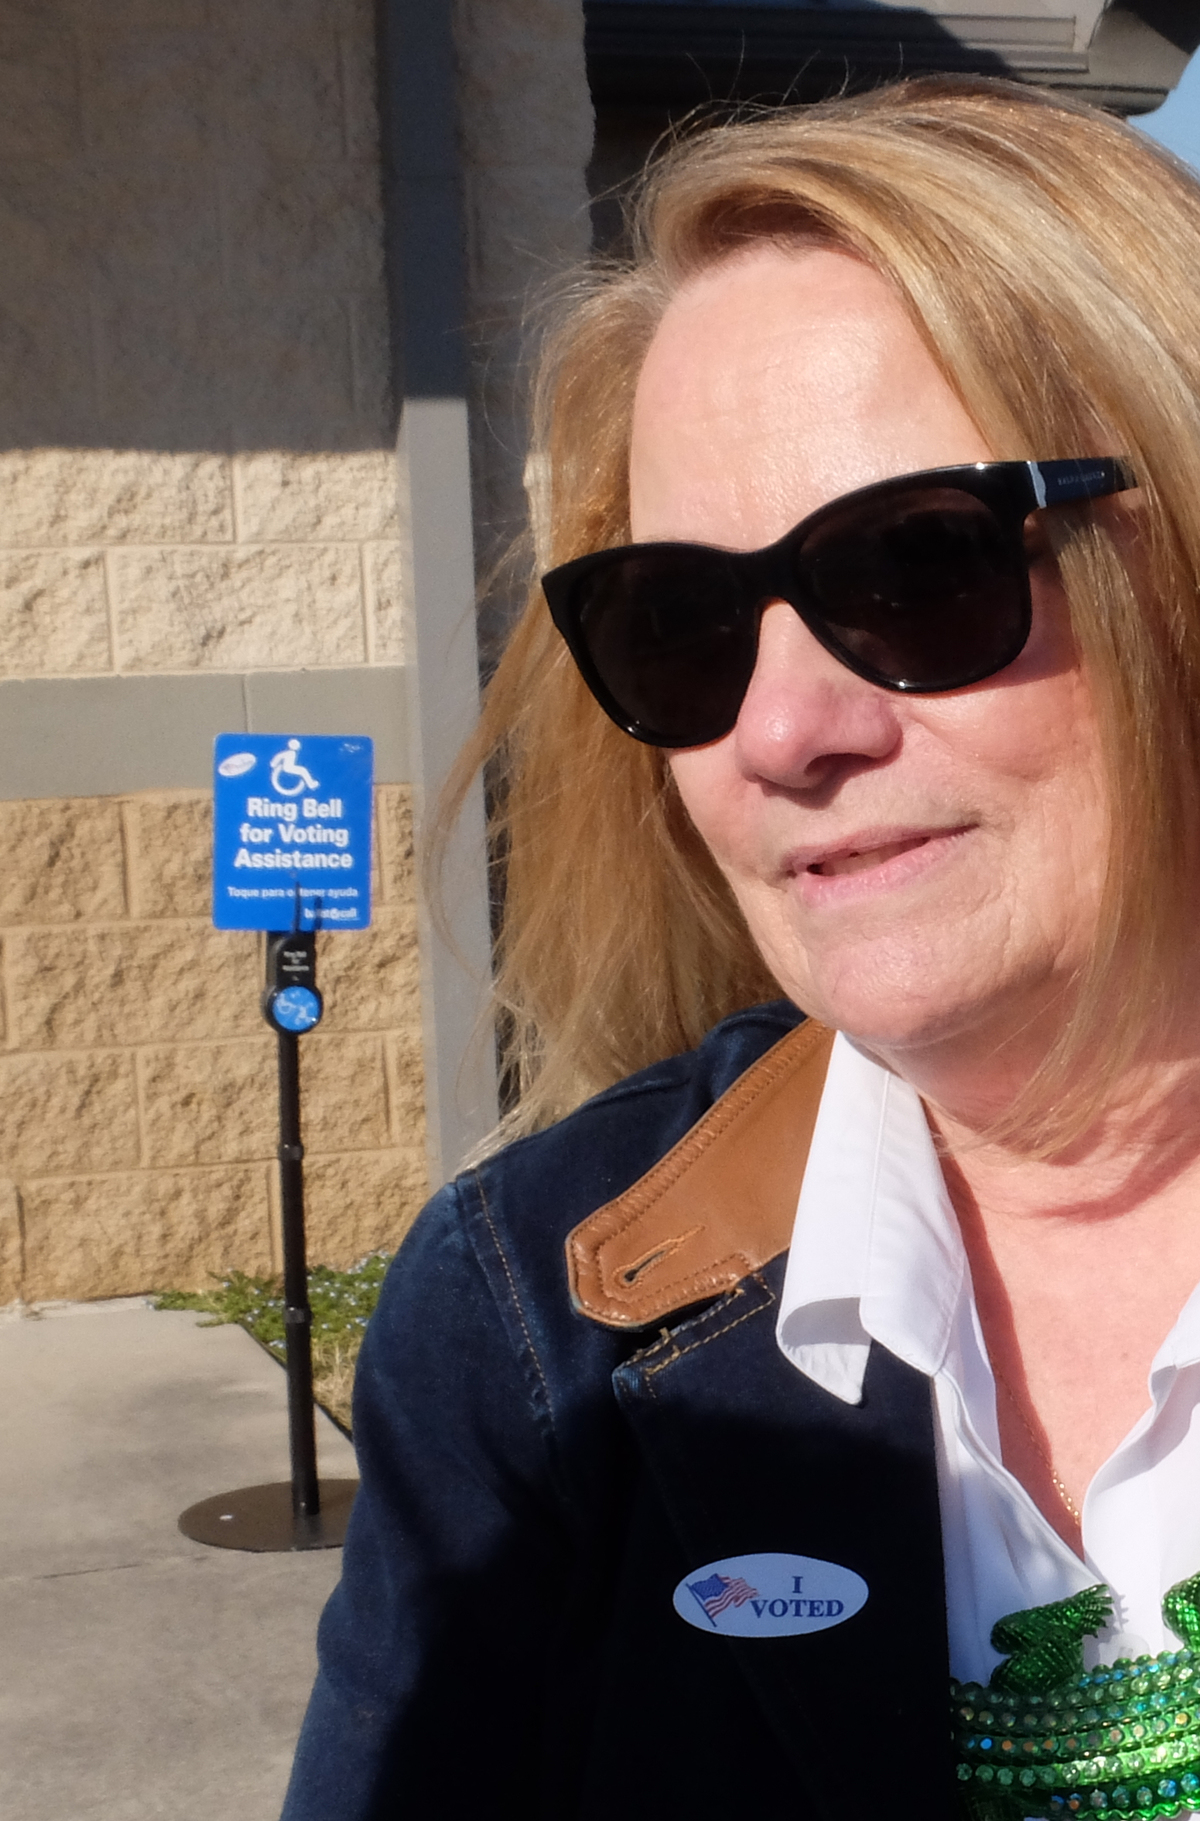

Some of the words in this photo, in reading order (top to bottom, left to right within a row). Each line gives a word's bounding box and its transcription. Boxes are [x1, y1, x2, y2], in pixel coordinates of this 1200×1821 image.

[247, 797, 298, 822] Ring
[303, 798, 343, 819] Bell
[239, 823, 273, 843] for
[278, 823, 350, 848] Voting
[233, 849, 354, 869] Assistance
[227, 886, 259, 899] Toque
[262, 889, 285, 899] para
[328, 887, 358, 899] ayuda
[792, 1576, 803, 1593] I
[750, 1599, 844, 1618] VOTED
